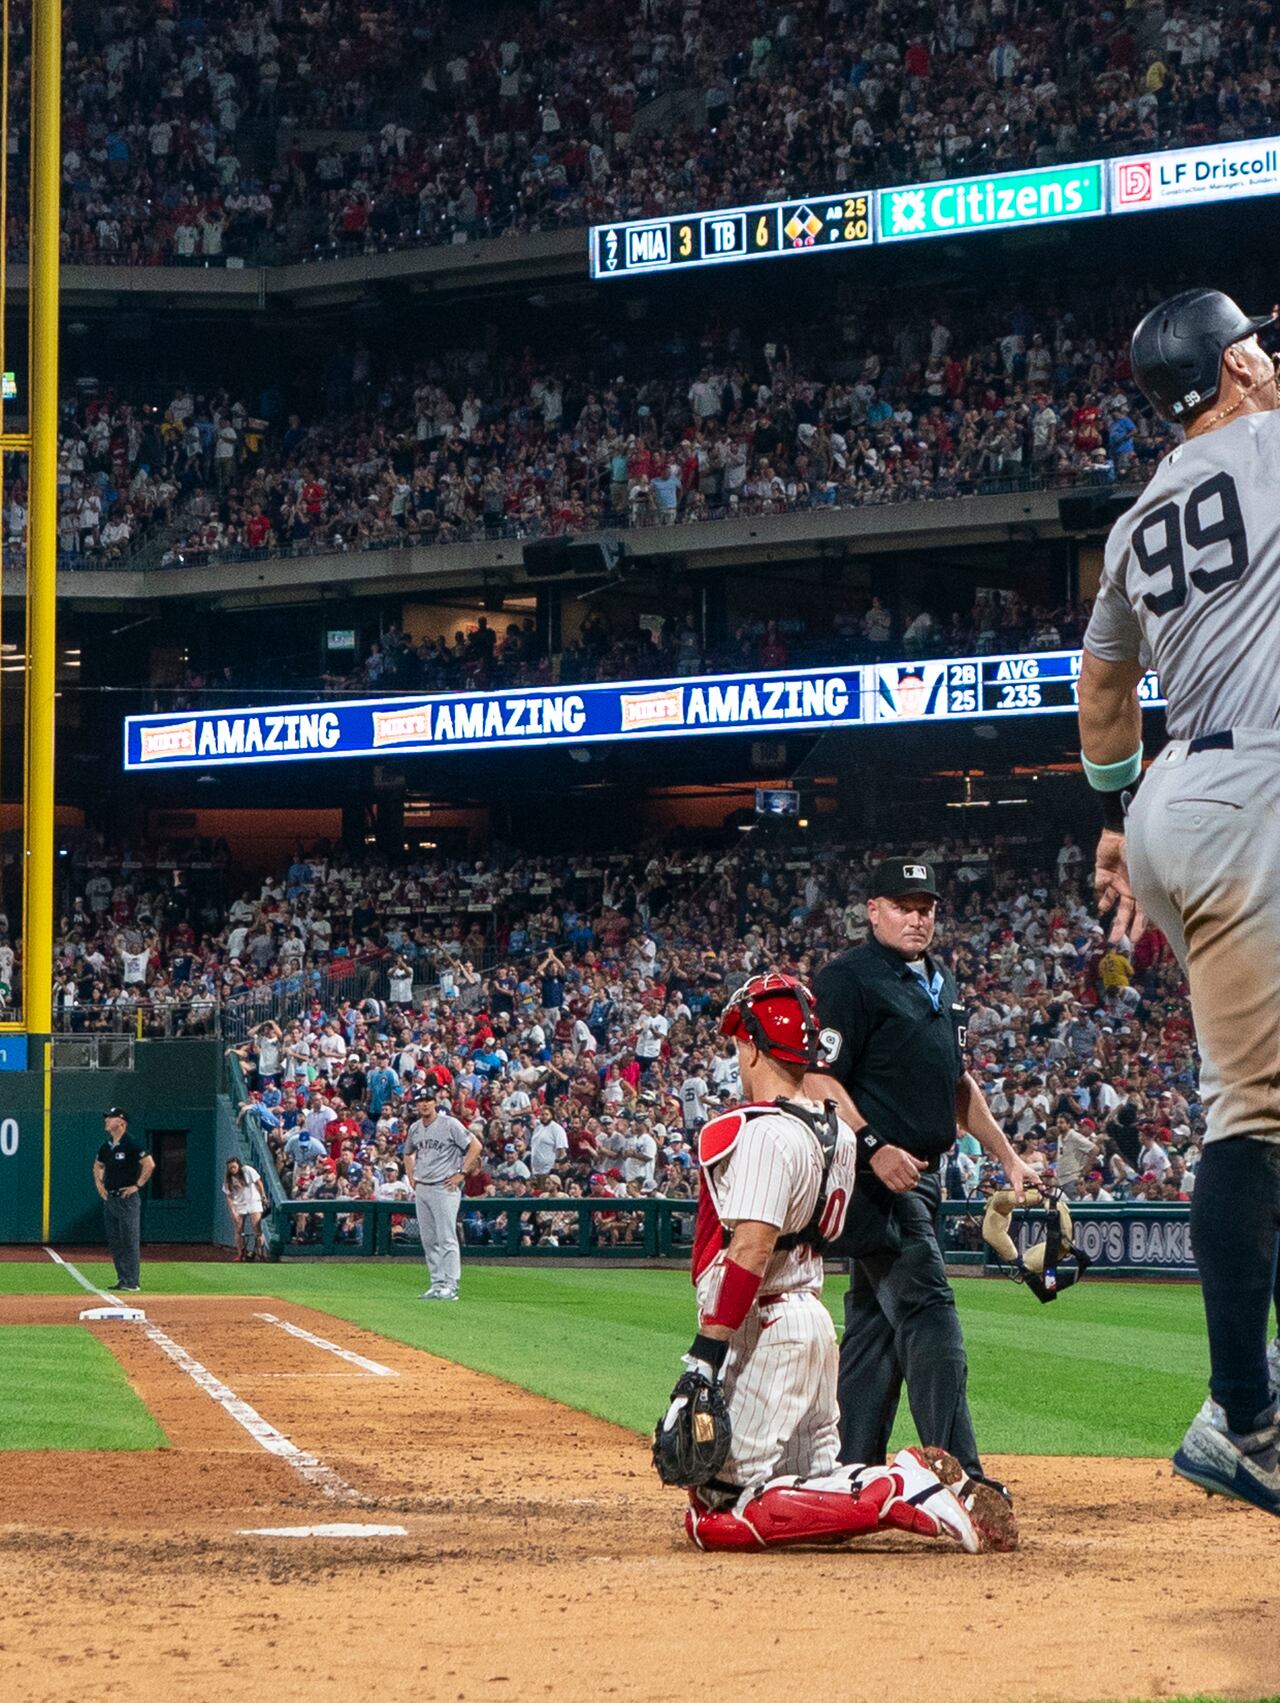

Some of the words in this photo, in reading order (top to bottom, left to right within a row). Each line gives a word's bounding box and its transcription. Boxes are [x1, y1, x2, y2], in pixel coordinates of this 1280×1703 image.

[1160, 164, 1187, 186] LF
[1195, 151, 1277, 181] Driscoll
[826, 206, 842, 220] AB
[844, 198, 866, 218] 25
[930, 180, 1083, 228] Citizens
[607, 242, 617, 259] 7
[632, 230, 665, 261] MIA
[679, 226, 692, 256] 3
[711, 221, 735, 251] TB
[756, 216, 768, 246] 6
[830, 228, 839, 241] P
[844, 220, 867, 240] 60
[1184, 390, 1200, 407] 99
[1132, 471, 1249, 618] 99
[950, 665, 976, 686] 2B
[997, 659, 1039, 681] AVG
[951, 690, 975, 712] 25
[996, 685, 1042, 710] .235
[198, 712, 341, 756] AMAZING
[434, 696, 586, 741] AMAZING
[686, 678, 849, 725] AMAZING
[818, 1027, 843, 1063] 9
